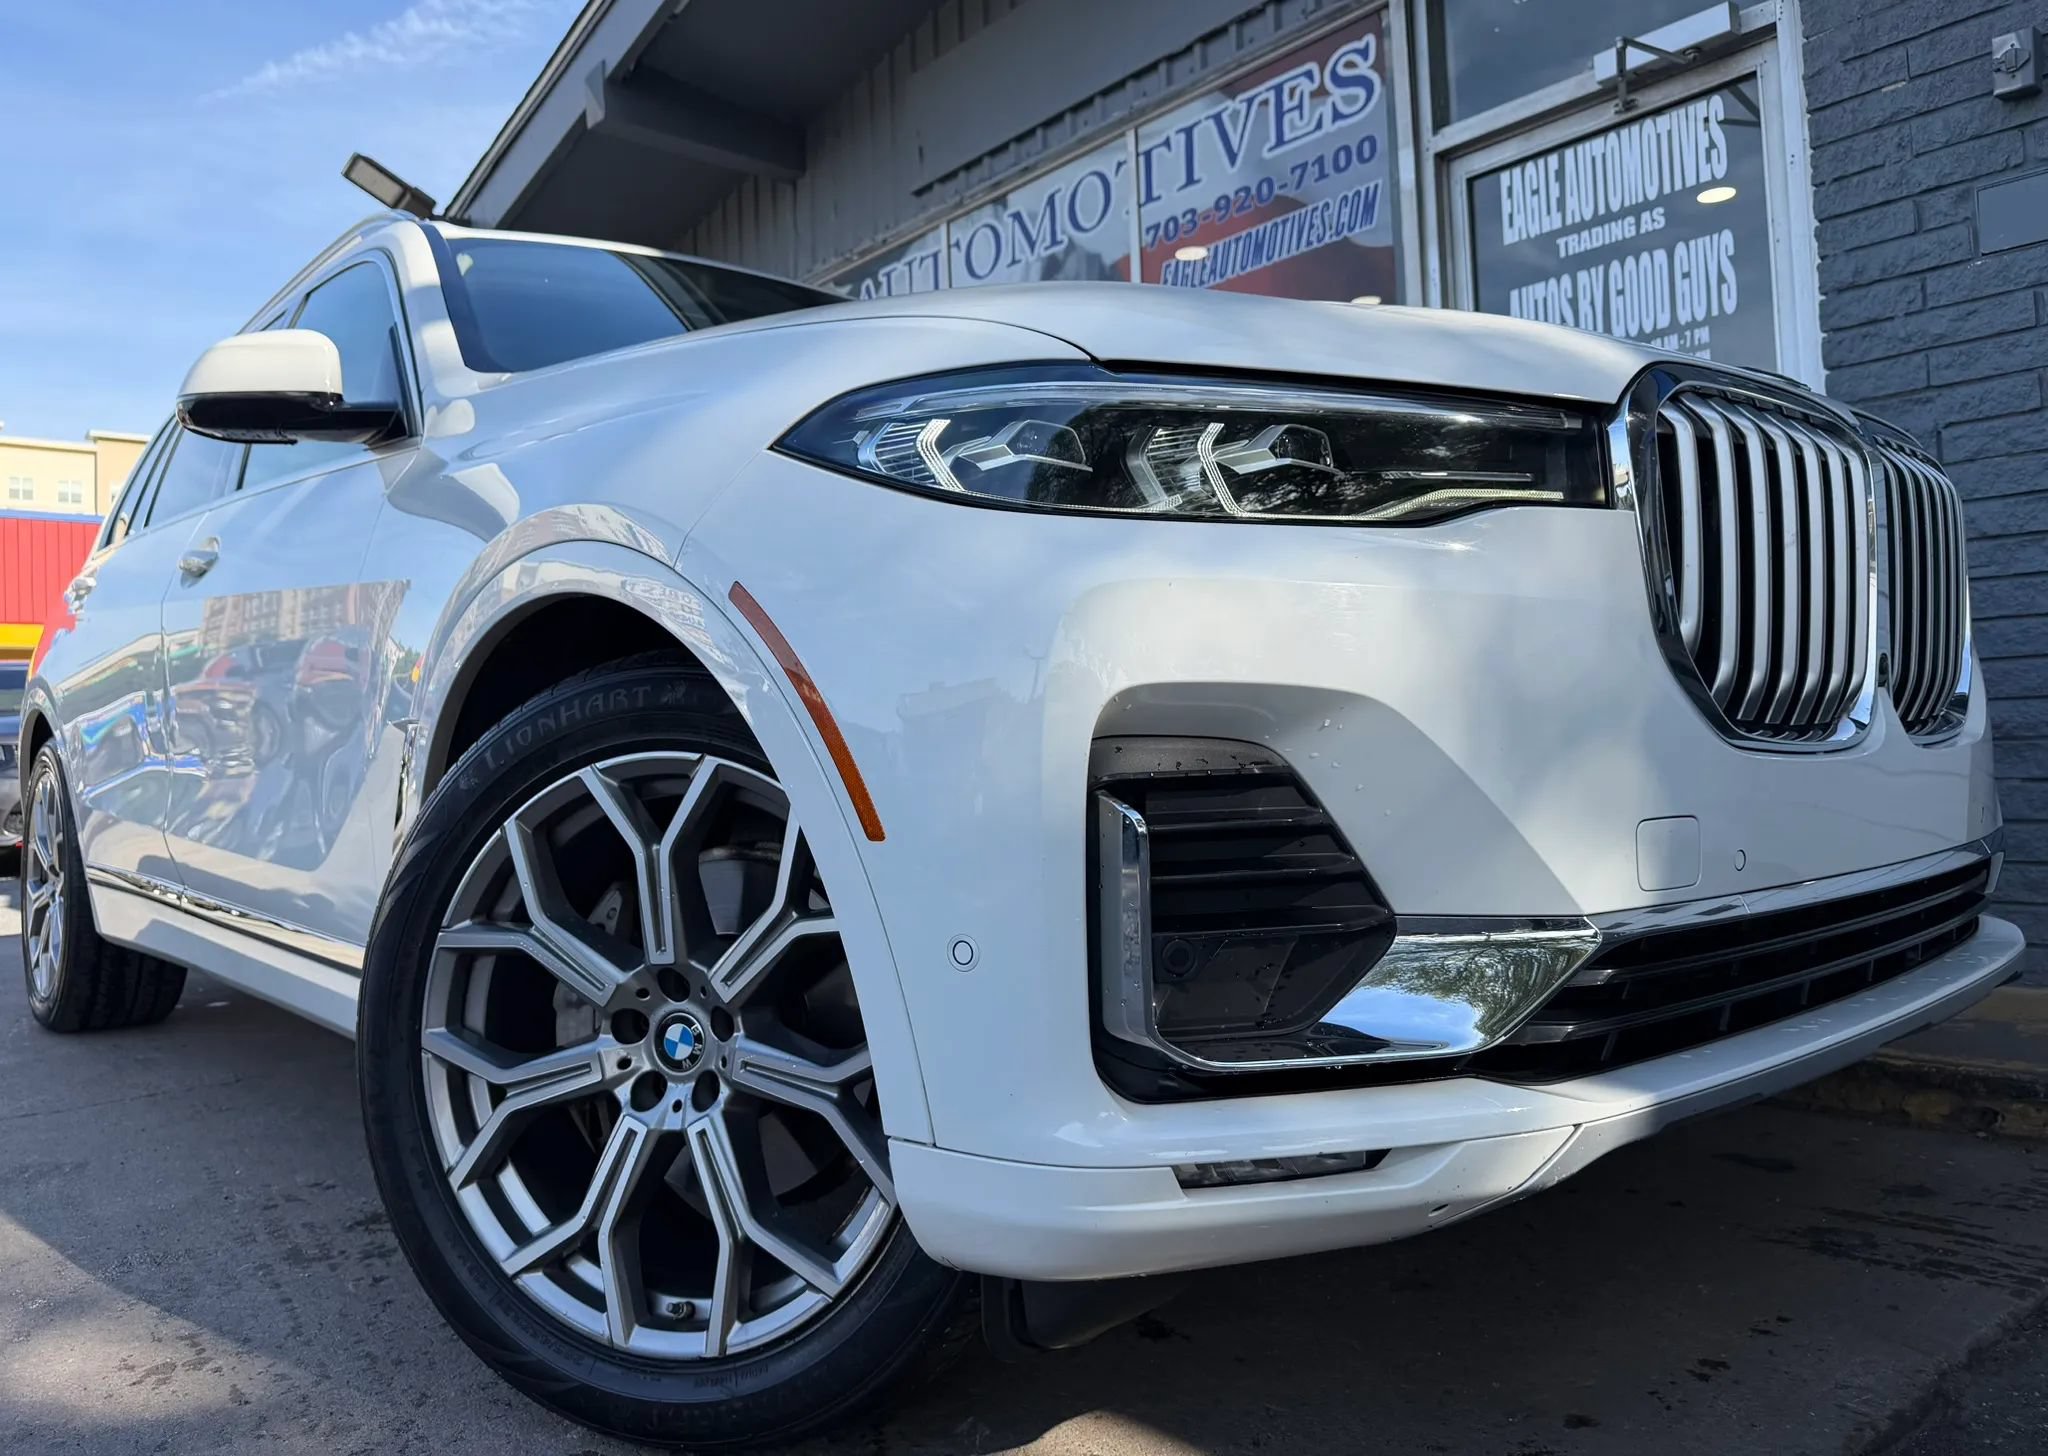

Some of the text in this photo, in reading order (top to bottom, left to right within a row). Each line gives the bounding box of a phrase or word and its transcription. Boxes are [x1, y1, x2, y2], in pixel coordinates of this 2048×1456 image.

[1145, 134, 1378, 249] 703-920-7100
[1500, 94, 1728, 246] EAGLE AUTOMOTIVES
[1556, 206, 1666, 258] TRADING AS
[1577, 264, 1604, 333] BY
[1608, 248, 1671, 338] GOOD
[1674, 228, 1738, 325] GUYS
[1693, 325, 1710, 346] PM
[484, 685, 652, 771] LIONHART
